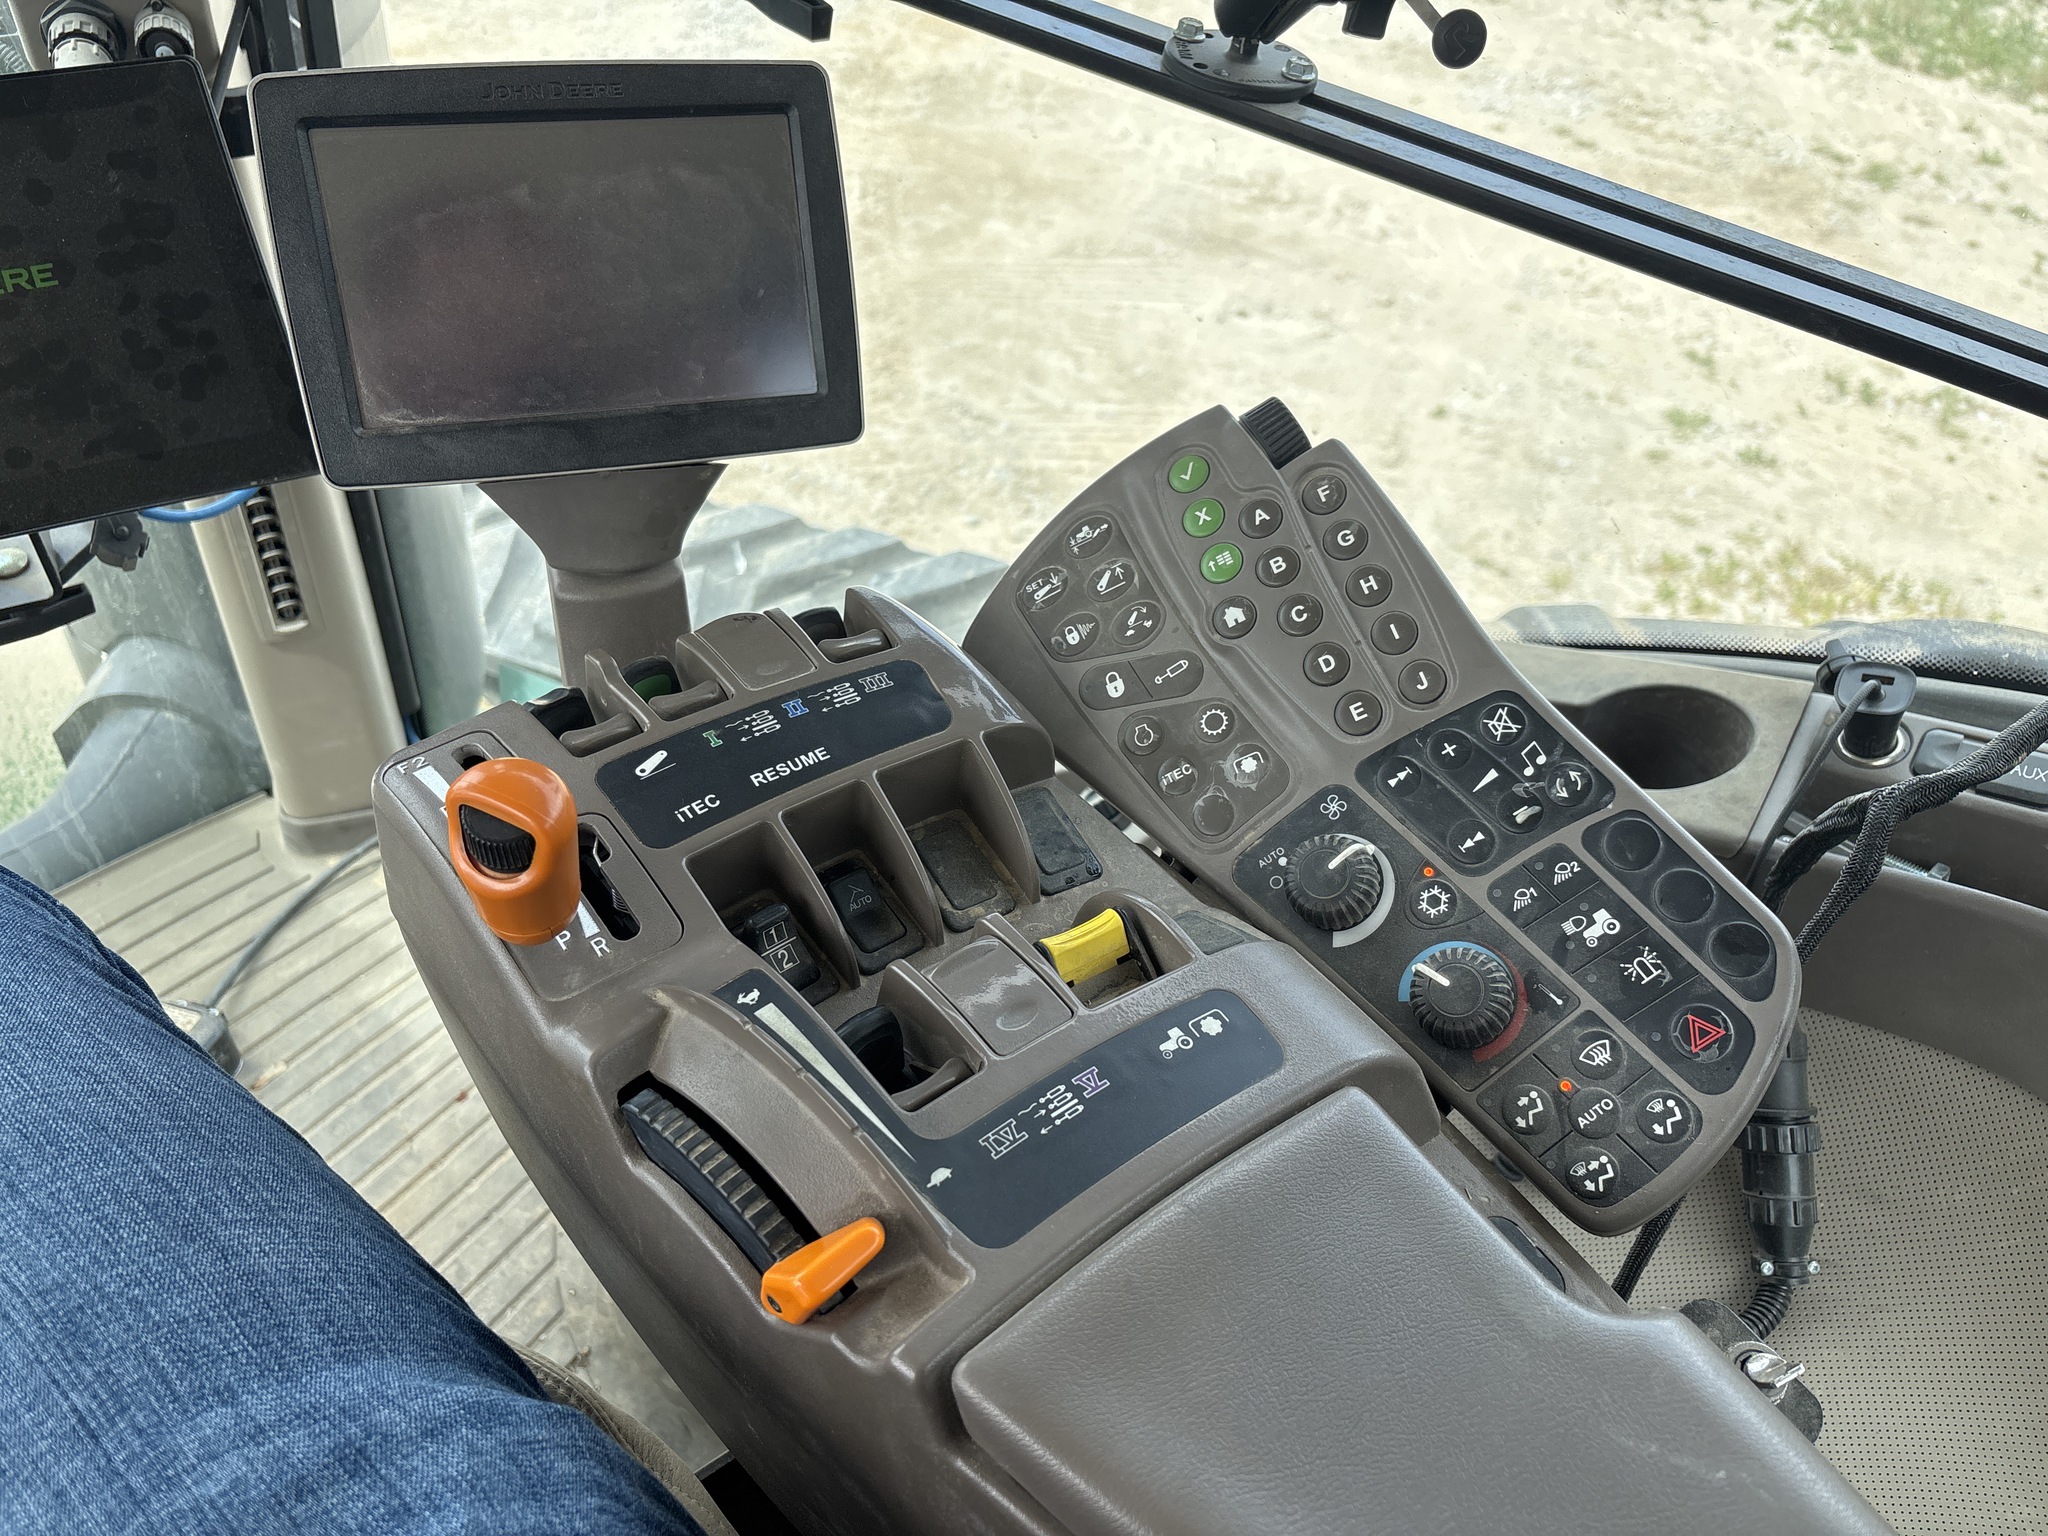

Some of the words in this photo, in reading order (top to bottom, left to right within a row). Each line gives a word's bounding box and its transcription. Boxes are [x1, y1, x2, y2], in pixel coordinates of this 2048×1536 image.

[482, 82, 544, 100] JOHN
[548, 81, 625, 99] DEERE
[0, 262, 59, 294] RE
[1316, 485, 1330, 502] F
[1254, 508, 1271, 526] A
[1336, 529, 1355, 547] G
[1268, 556, 1287, 574] B
[1025, 578, 1043, 593] SET
[1359, 575, 1379, 595] H
[1291, 605, 1308, 622] C
[1389, 623, 1400, 640] I
[1317, 654, 1336, 673] D
[1415, 671, 1429, 691] J
[1348, 702, 1368, 722] E
[749, 746, 831, 787] RESUME
[1161, 763, 1193, 786] iTEC
[2009, 764, 2048, 783] AUX
[674, 793, 721, 823] iTEC
[1258, 847, 1285, 868] AUTO
[1570, 861, 1581, 873] 2
[1529, 887, 1538, 897] 1
[849, 894, 872, 912] AUTO
[555, 930, 571, 951] P
[590, 937, 613, 958] R
[778, 949, 793, 969] 2
[1577, 1098, 1614, 1130] AUTO
